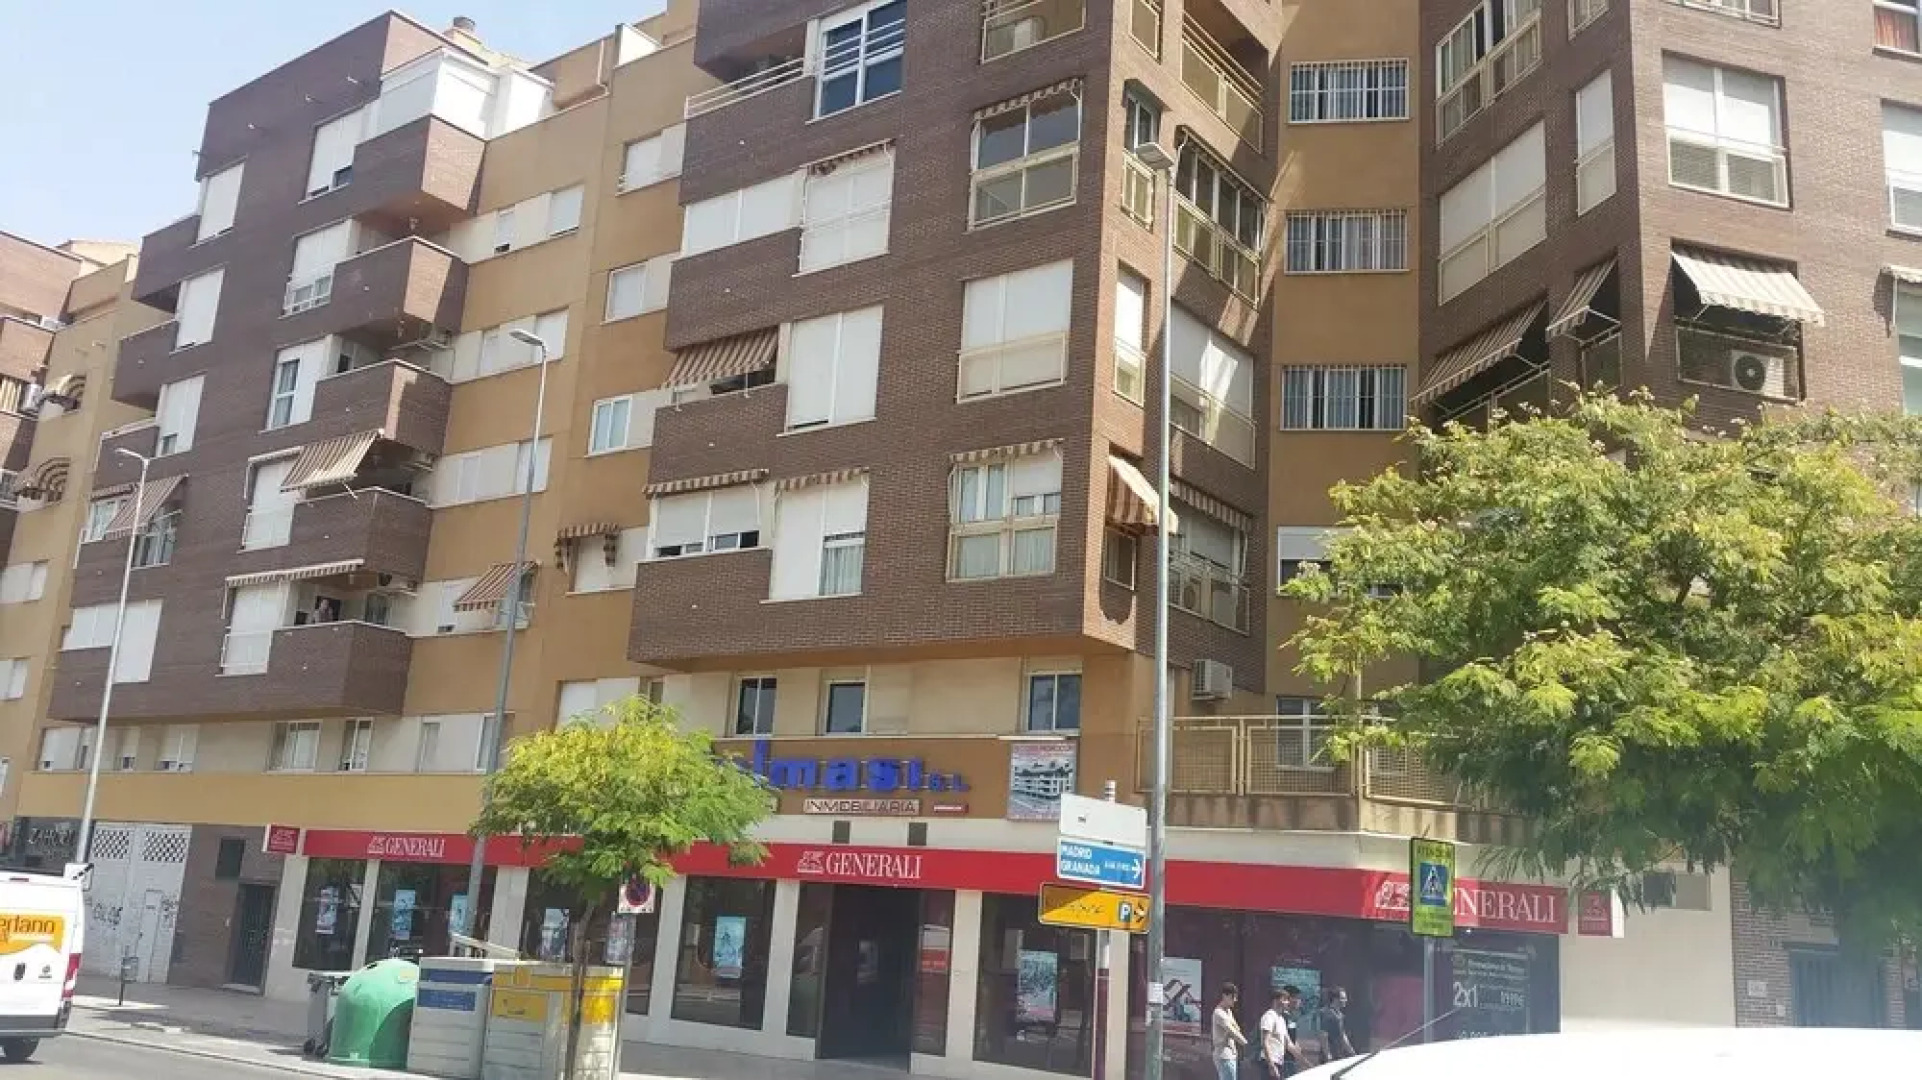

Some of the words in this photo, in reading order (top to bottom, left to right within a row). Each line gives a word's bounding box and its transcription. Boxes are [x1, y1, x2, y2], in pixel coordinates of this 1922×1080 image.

[385, 837, 445, 858] GENERALI
[1061, 844, 1093, 860] MADRID
[826, 853, 922, 879] GENERALI
[1061, 859, 1101, 876] GRANADA
[1453, 886, 1556, 924] NERALI
[1453, 981, 1478, 1008] 2x1
